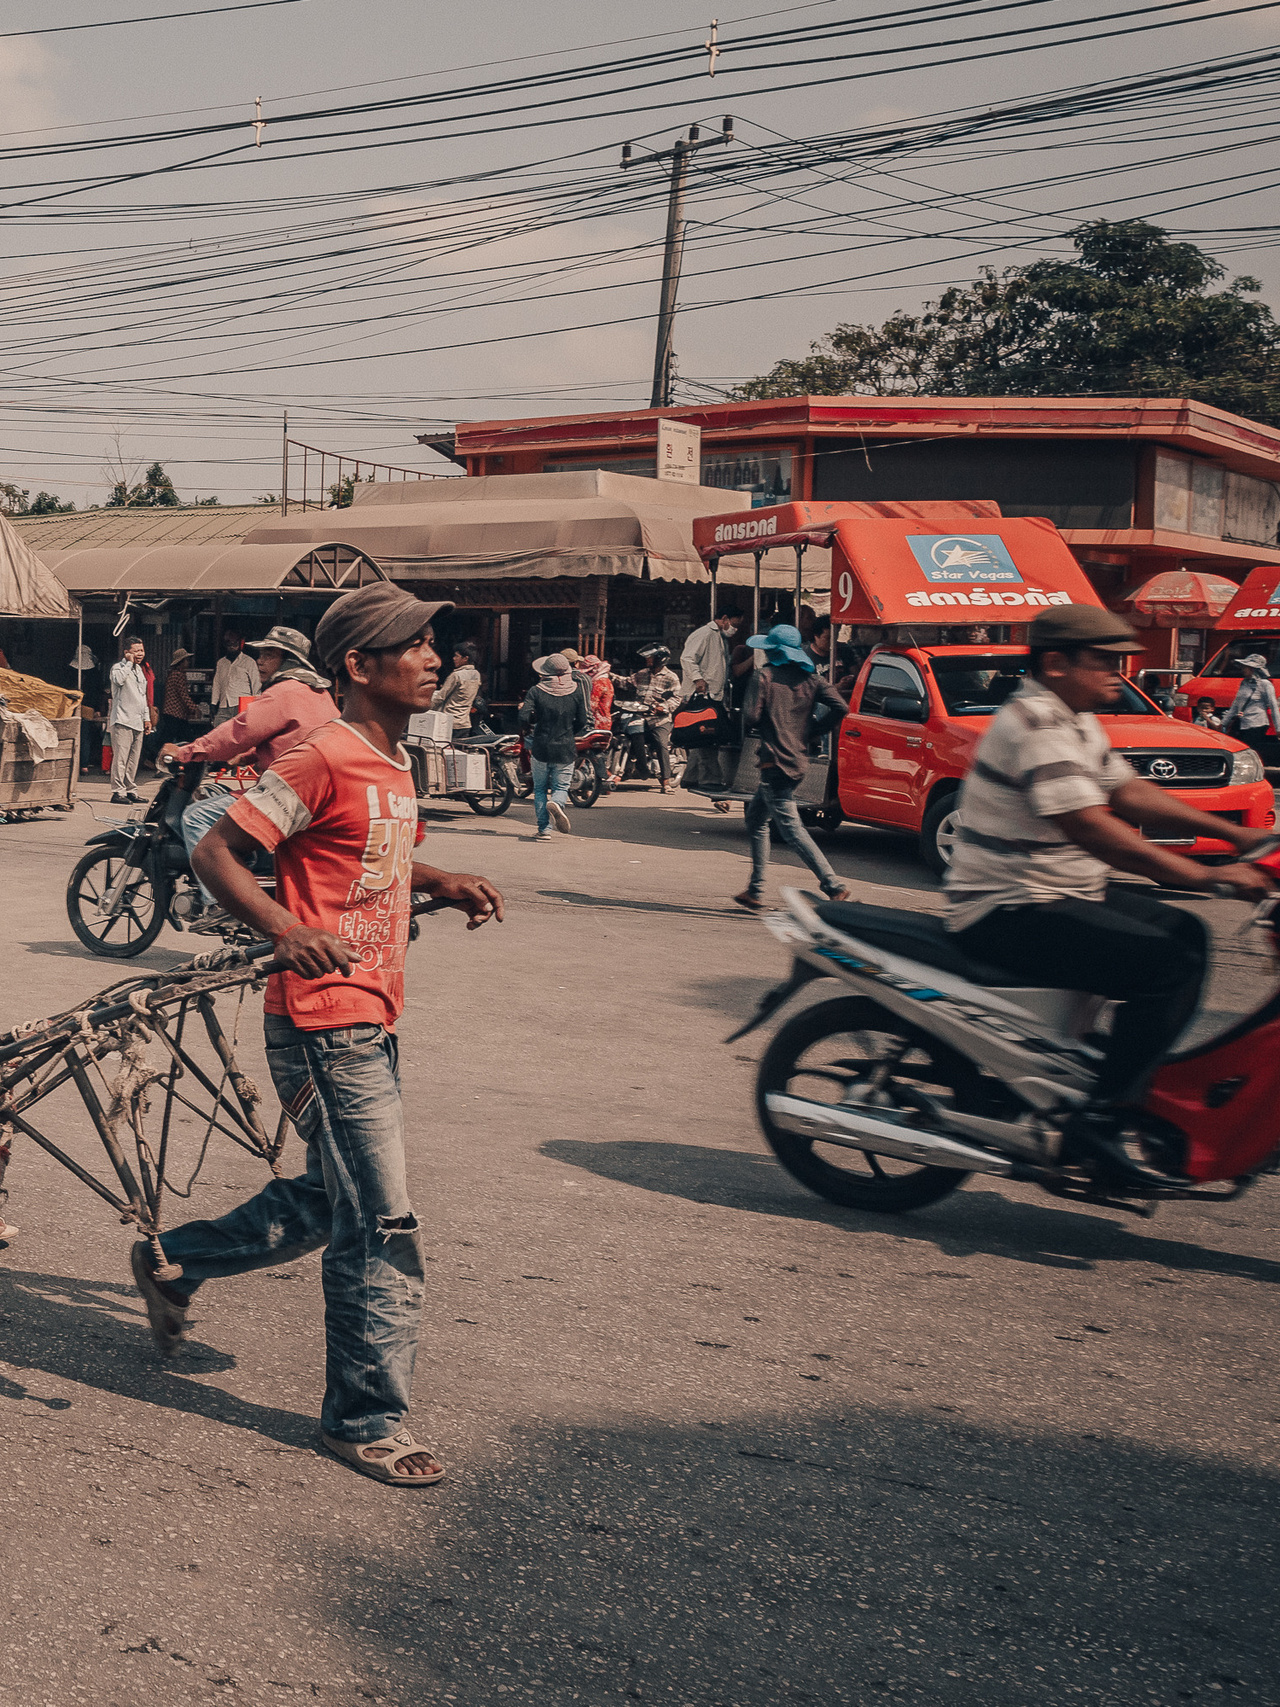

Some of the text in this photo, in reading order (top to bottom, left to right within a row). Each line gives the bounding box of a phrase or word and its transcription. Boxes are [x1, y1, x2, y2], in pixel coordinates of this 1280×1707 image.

[931, 570, 1015, 581] Star Vegas
[838, 571, 853, 613] 9
[905, 587, 1073, 607] สตาร์เวกัส
[1234, 608, 1280, 618] สตา
[366, 785, 381, 818] I
[338, 911, 391, 943] that
